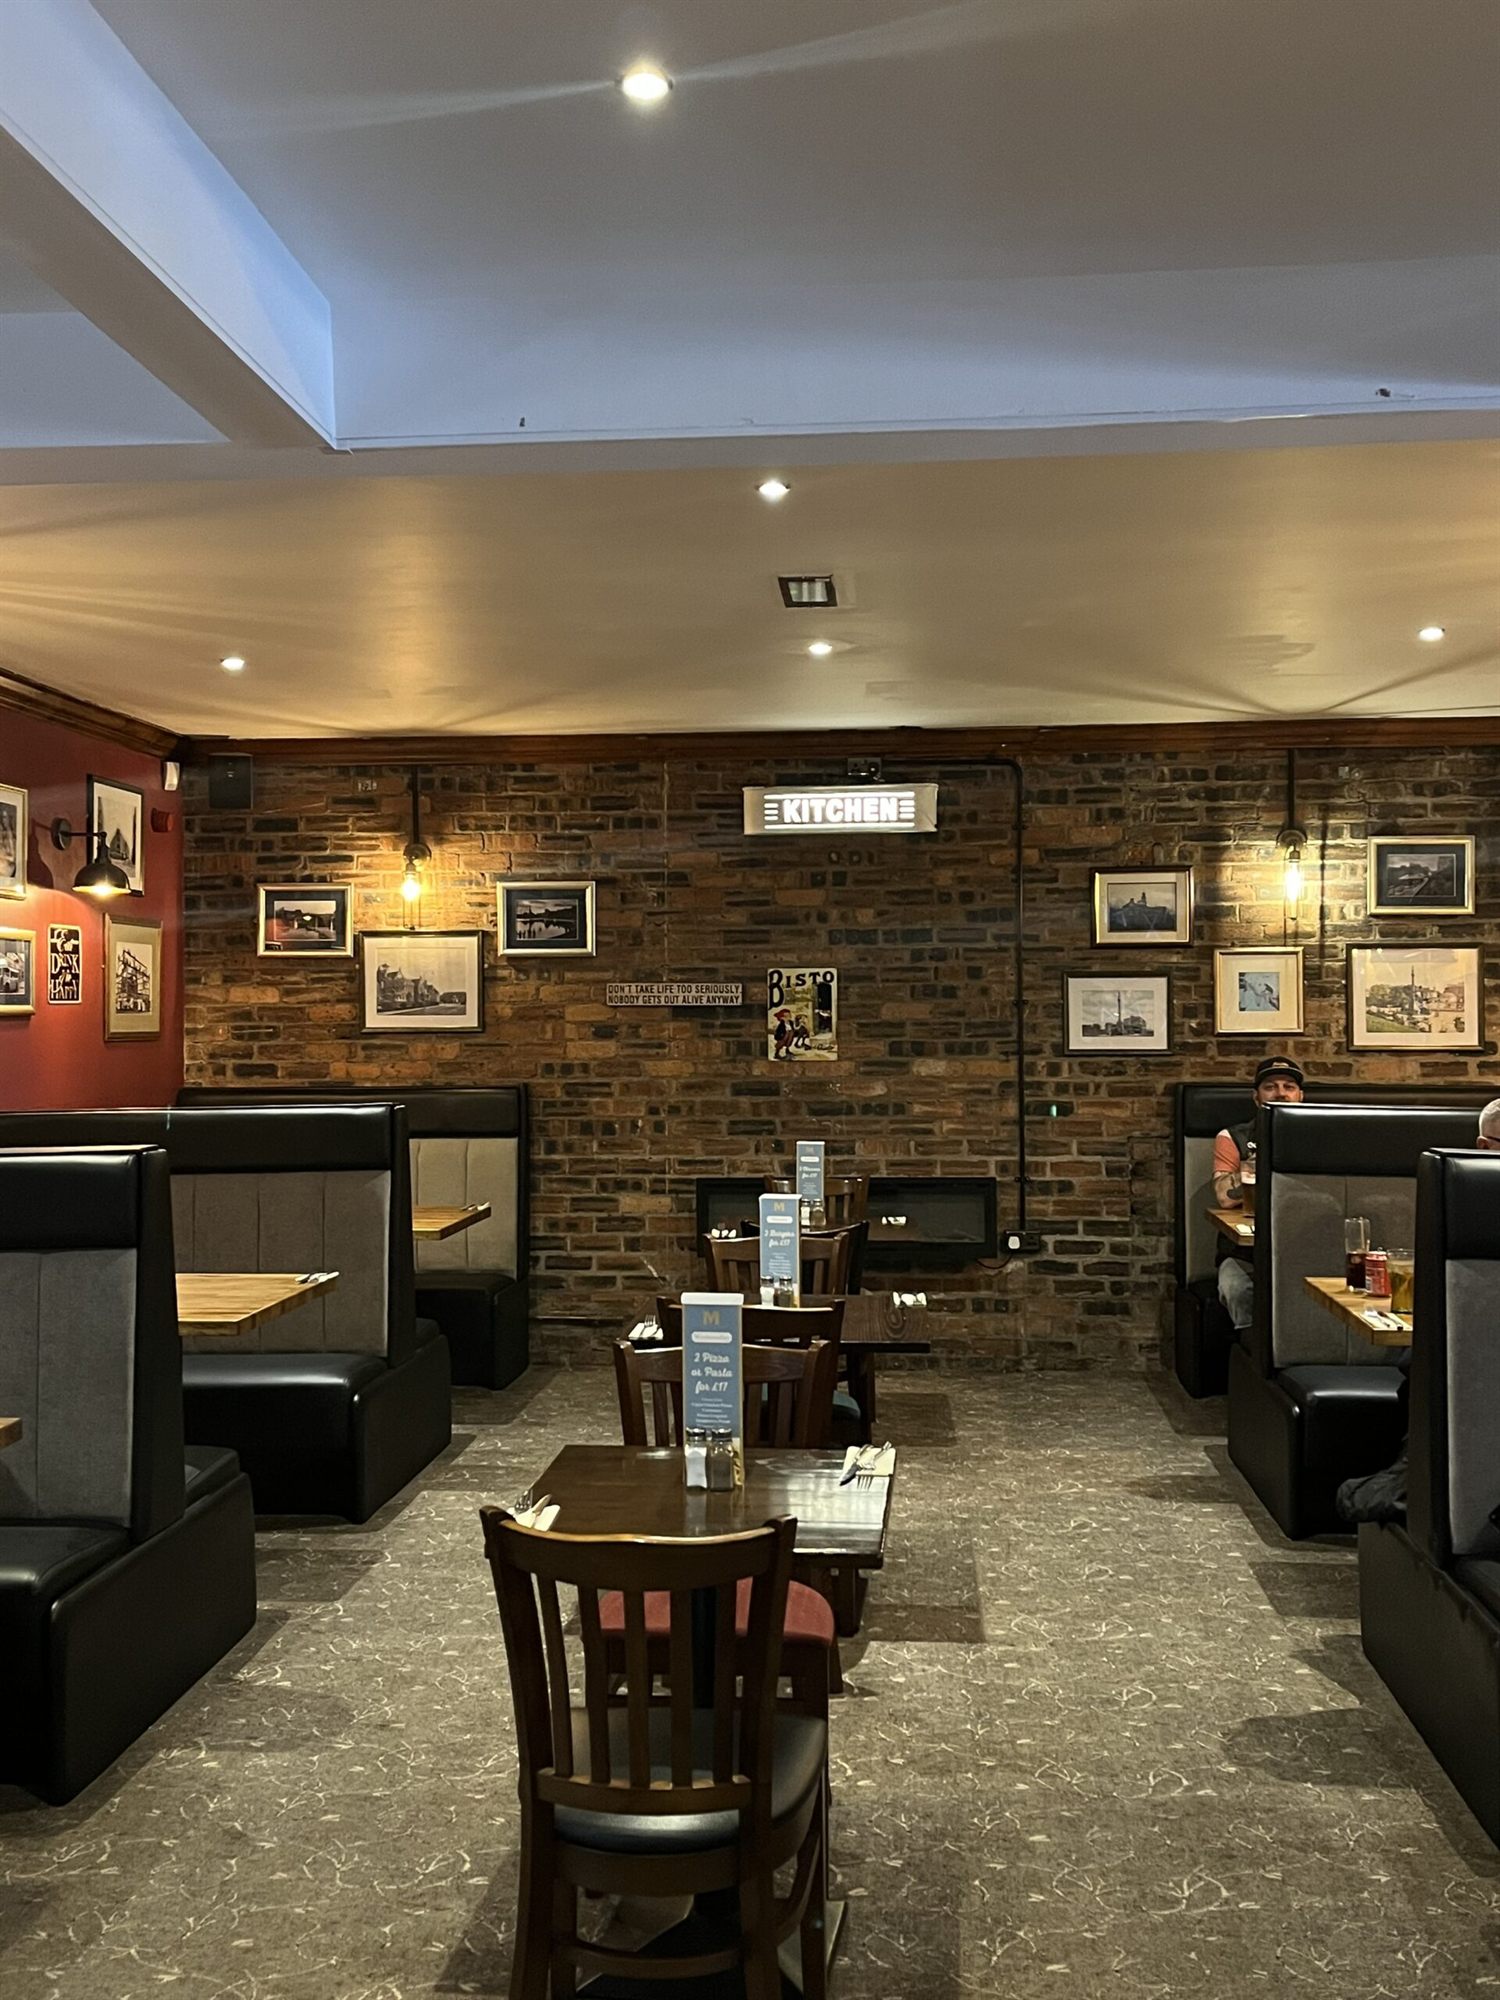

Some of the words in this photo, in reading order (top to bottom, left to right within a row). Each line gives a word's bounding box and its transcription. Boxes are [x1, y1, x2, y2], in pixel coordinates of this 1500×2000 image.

[783, 797, 898, 823] KITCHEN
[608, 984, 632, 994] DON'T
[635, 984, 655, 994] TAKE
[657, 984, 676, 994] LIFE
[677, 984, 692, 994] TOO
[768, 969, 834, 1010] BISTO
[608, 995, 640, 1004] NOBODY
[642, 995, 661, 1004] GETS
[664, 995, 679, 1004] OUT
[681, 995, 704, 1004] ALIVE
[703, 1311, 720, 1325] M
[694, 1352, 700, 1362] 2
[702, 1352, 730, 1363] Pizza
[691, 1369, 702, 1377] or
[704, 1366, 733, 1377] Pasta
[695, 1381, 709, 1394] for
[711, 1381, 728, 1392] £17
